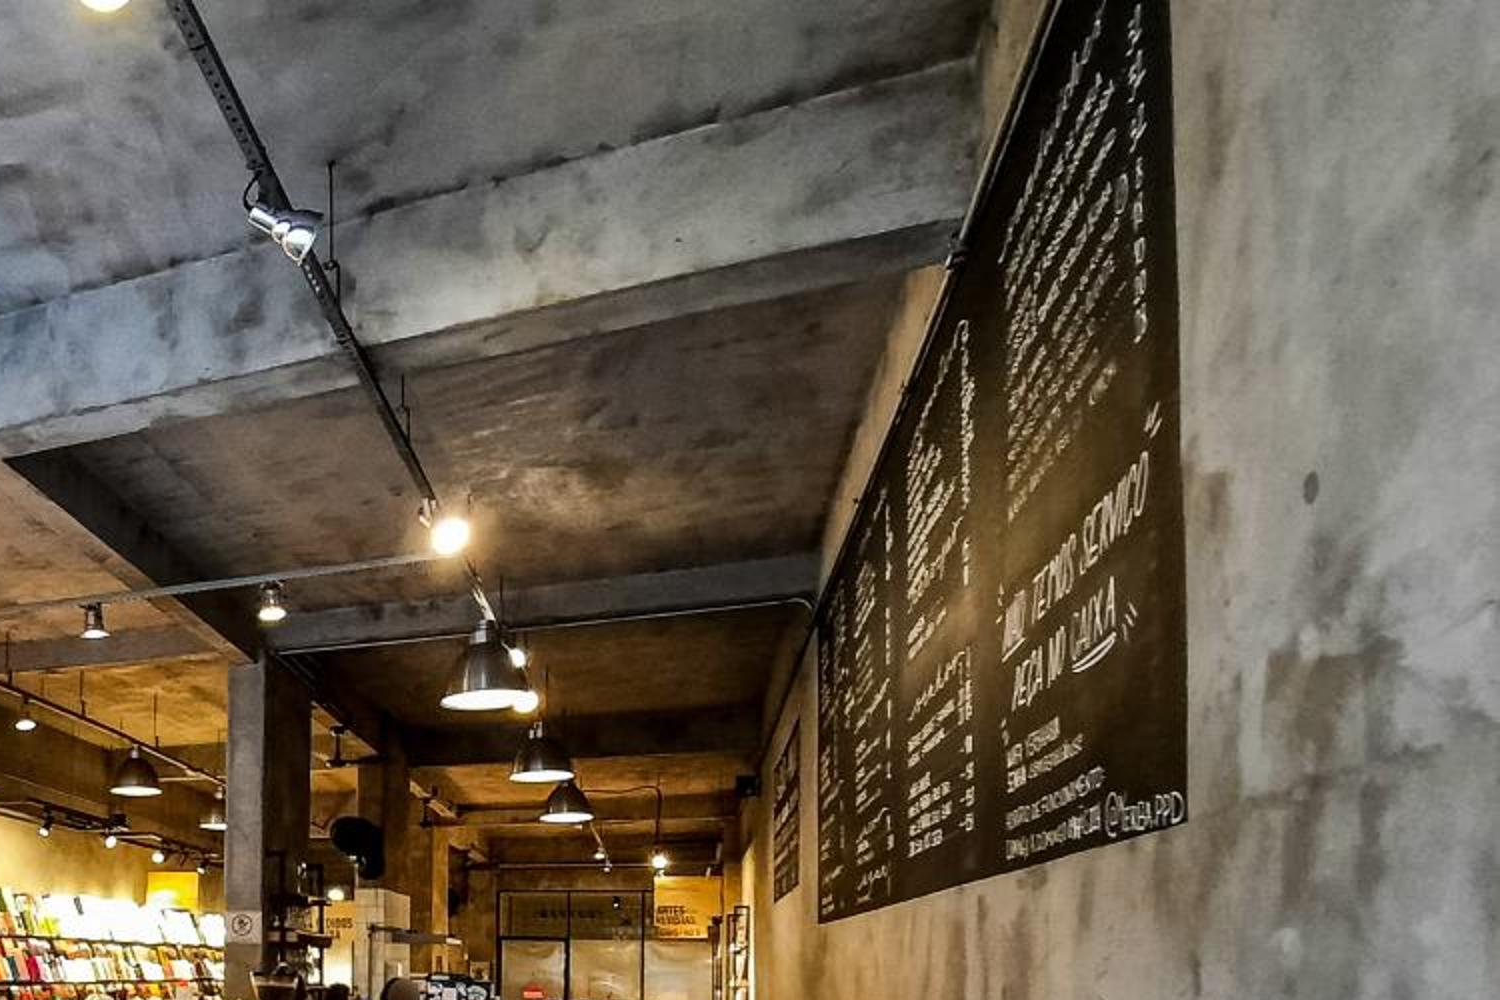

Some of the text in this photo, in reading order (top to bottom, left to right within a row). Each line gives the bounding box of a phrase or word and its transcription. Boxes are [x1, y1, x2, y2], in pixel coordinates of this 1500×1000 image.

[1032, 533, 1077, 625] TEMOS
[1080, 450, 1150, 576] SERVIÇO
[1011, 643, 1044, 713] PEÇA
[1046, 625, 1067, 689] NO
[1069, 574, 1117, 662] CAIXA
